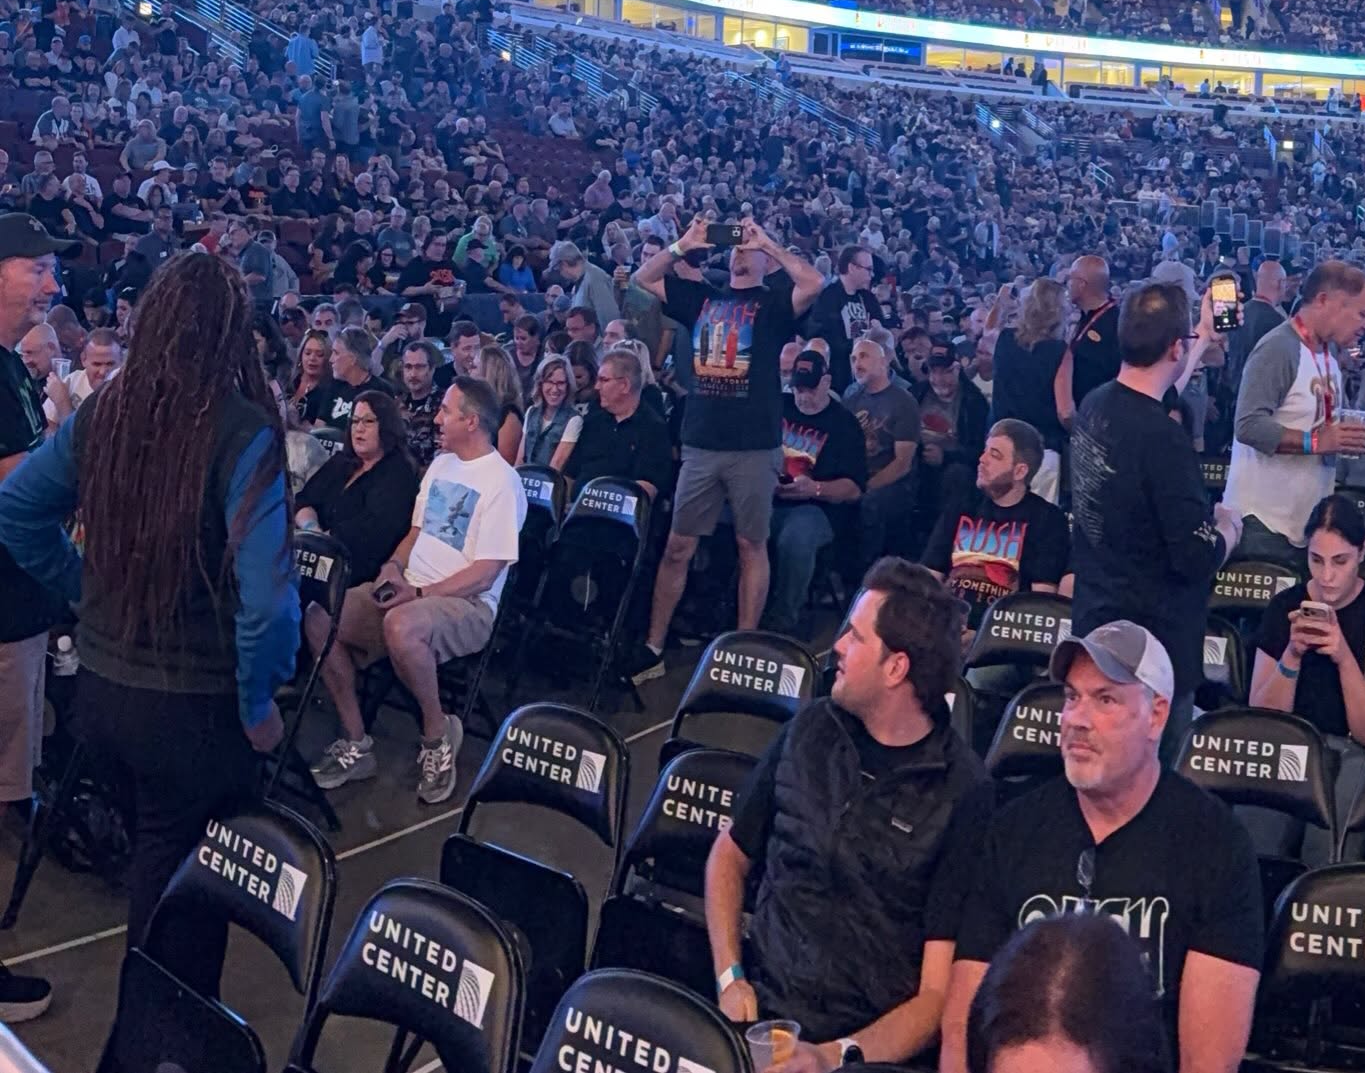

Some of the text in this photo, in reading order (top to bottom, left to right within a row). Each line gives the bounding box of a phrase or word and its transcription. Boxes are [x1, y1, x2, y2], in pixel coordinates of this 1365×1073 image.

[699, 298, 760, 326] RUSH
[582, 497, 621, 513] CENTER
[585, 486, 623, 502] UNITED
[953, 514, 1028, 561] RUSH
[1216, 570, 1272, 587] UNITED
[1214, 584, 1271, 600] CENTER
[993, 610, 1056, 627] UNITED
[991, 626, 1053, 644] CENTER
[713, 650, 778, 674] UNITED
[709, 668, 775, 694] CENTER
[507, 725, 577, 761] UNITED
[1191, 734, 1274, 758] UNITED
[502, 747, 572, 784] CENTER
[1190, 754, 1272, 780] CENTER
[205, 819, 278, 873] UNITED
[198, 845, 271, 903] CENTER
[370, 910, 456, 972] UNITED
[362, 943, 450, 1008] CENTER
[565, 1007, 671, 1073] UNITED
